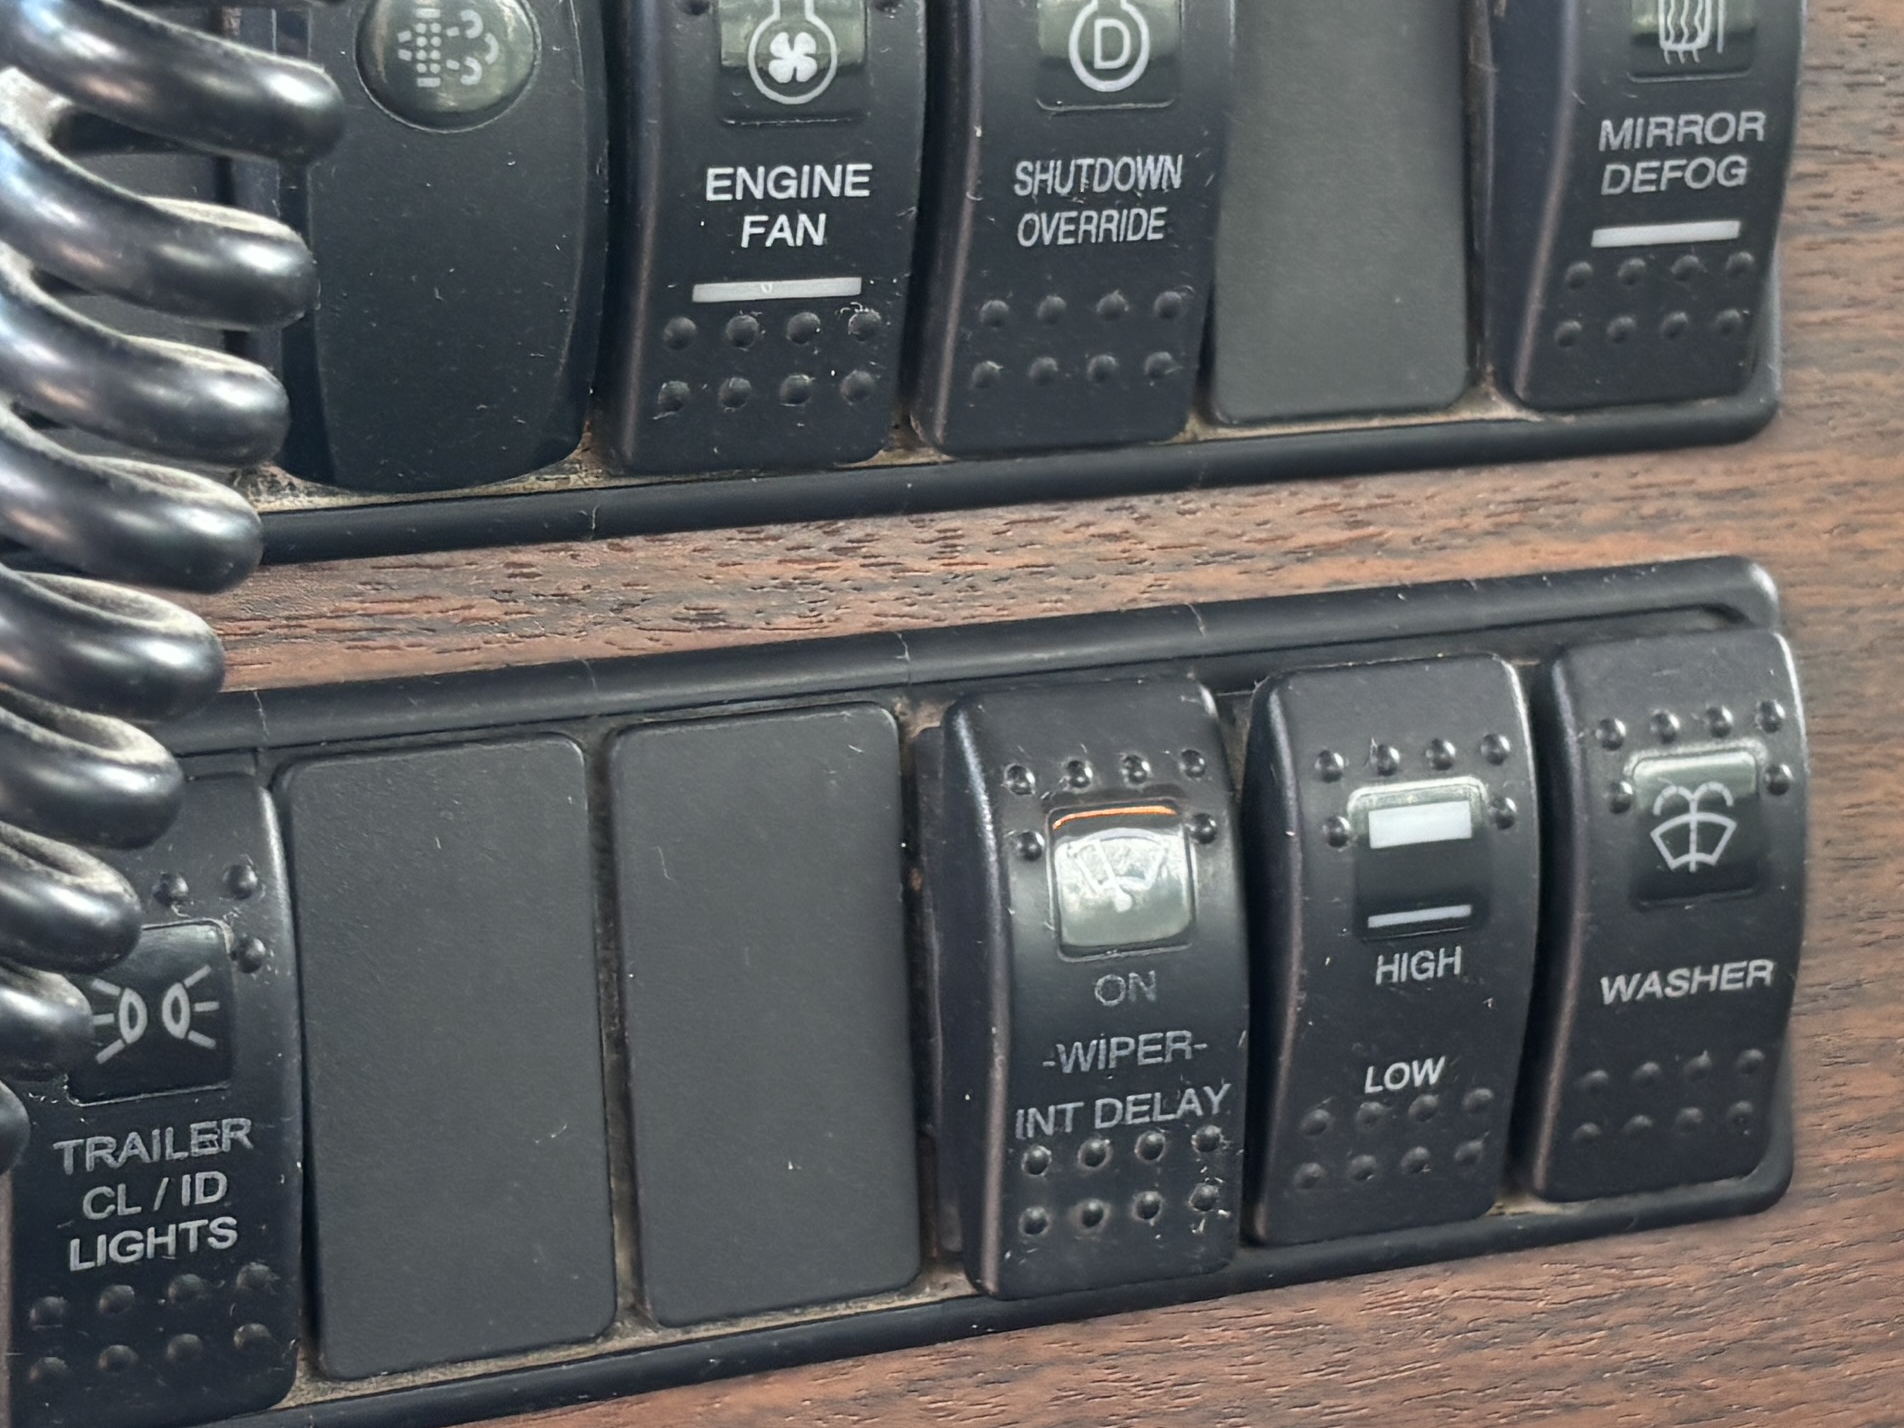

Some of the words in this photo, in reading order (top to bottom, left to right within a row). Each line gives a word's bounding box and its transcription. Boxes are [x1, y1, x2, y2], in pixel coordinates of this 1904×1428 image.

[1597, 109, 1767, 153] MIRROR
[705, 162, 873, 202] ENGINE
[1013, 152, 1184, 197] SHUTDOWN
[1600, 154, 1748, 197] DEFOG
[740, 212, 828, 249] FAN
[1016, 207, 1167, 249] OVERRIDE
[1374, 945, 1462, 987] HIGH
[1600, 958, 1774, 1007] WASHER
[1095, 971, 1157, 1007] ON
[1363, 1055, 1446, 1095] LOW
[1014, 1102, 1083, 1140] INT
[1095, 1083, 1232, 1132] DELAY
[53, 1116, 253, 1173] TRAILER
[68, 1218, 239, 1273] LIGHTS
